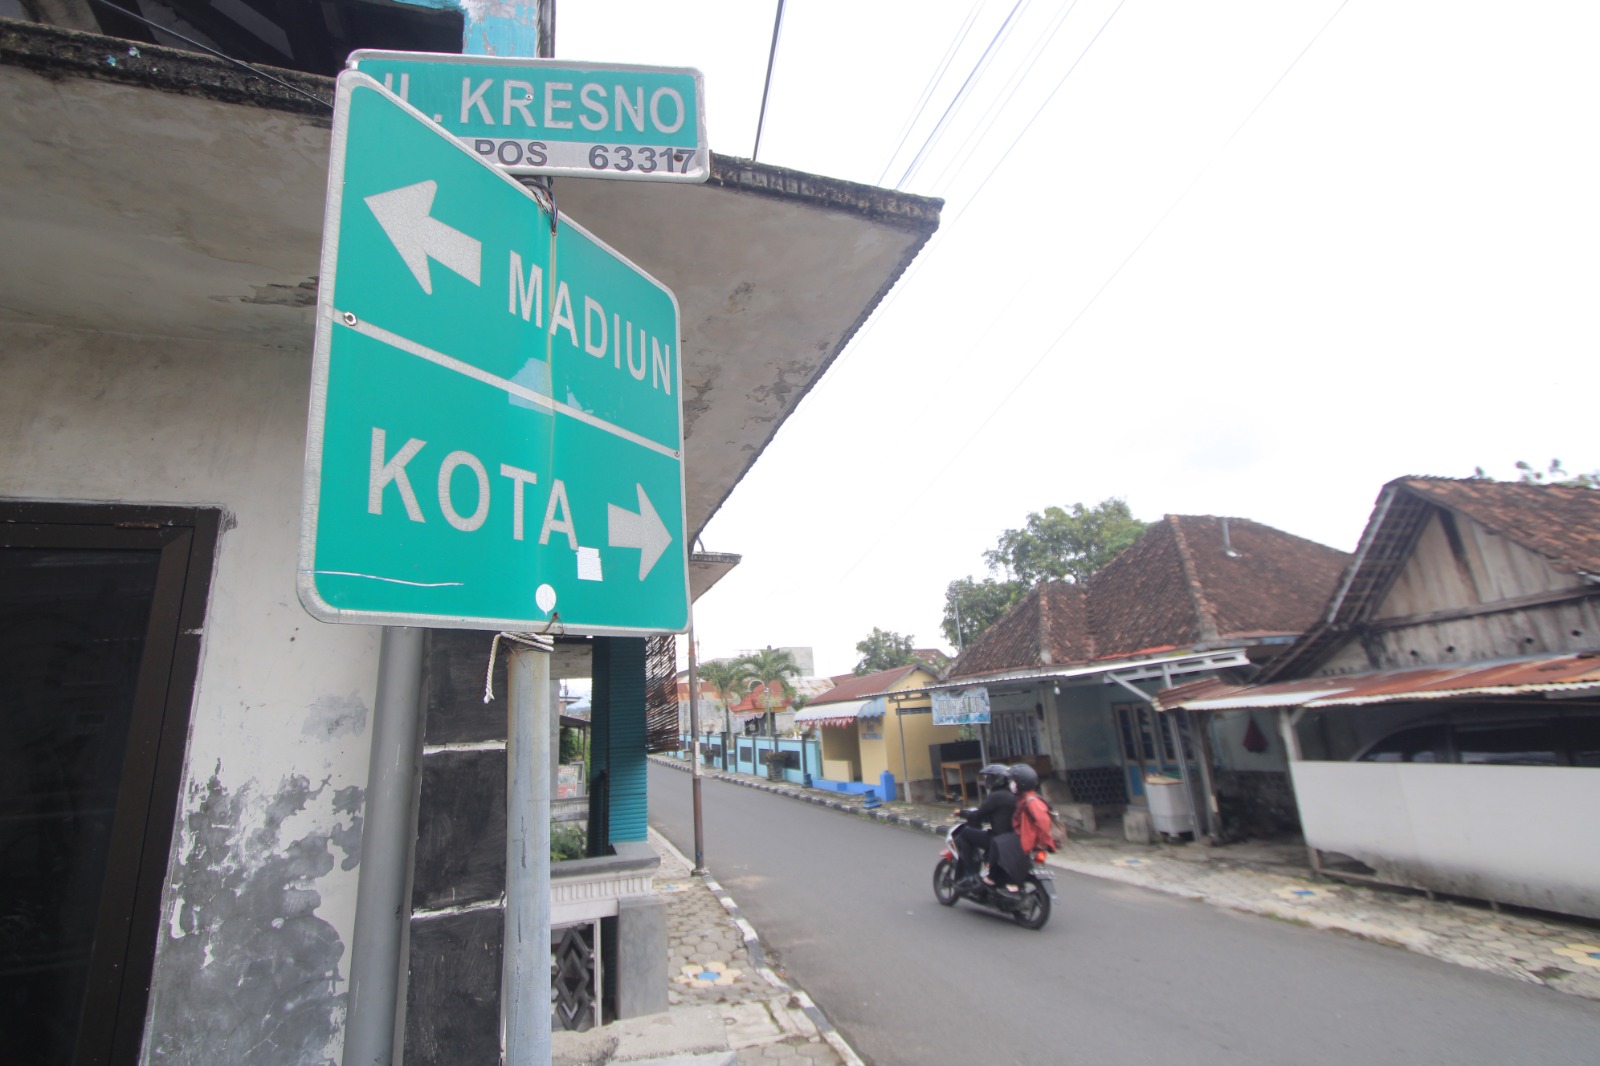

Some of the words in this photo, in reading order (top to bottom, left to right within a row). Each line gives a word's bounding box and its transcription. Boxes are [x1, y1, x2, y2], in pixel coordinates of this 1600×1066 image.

[460, 77, 685, 134] KRESNO
[475, 139, 548, 167] POS
[588, 145, 696, 174] 63317
[508, 250, 671, 395] MADIUN
[368, 427, 578, 551] KOTA
